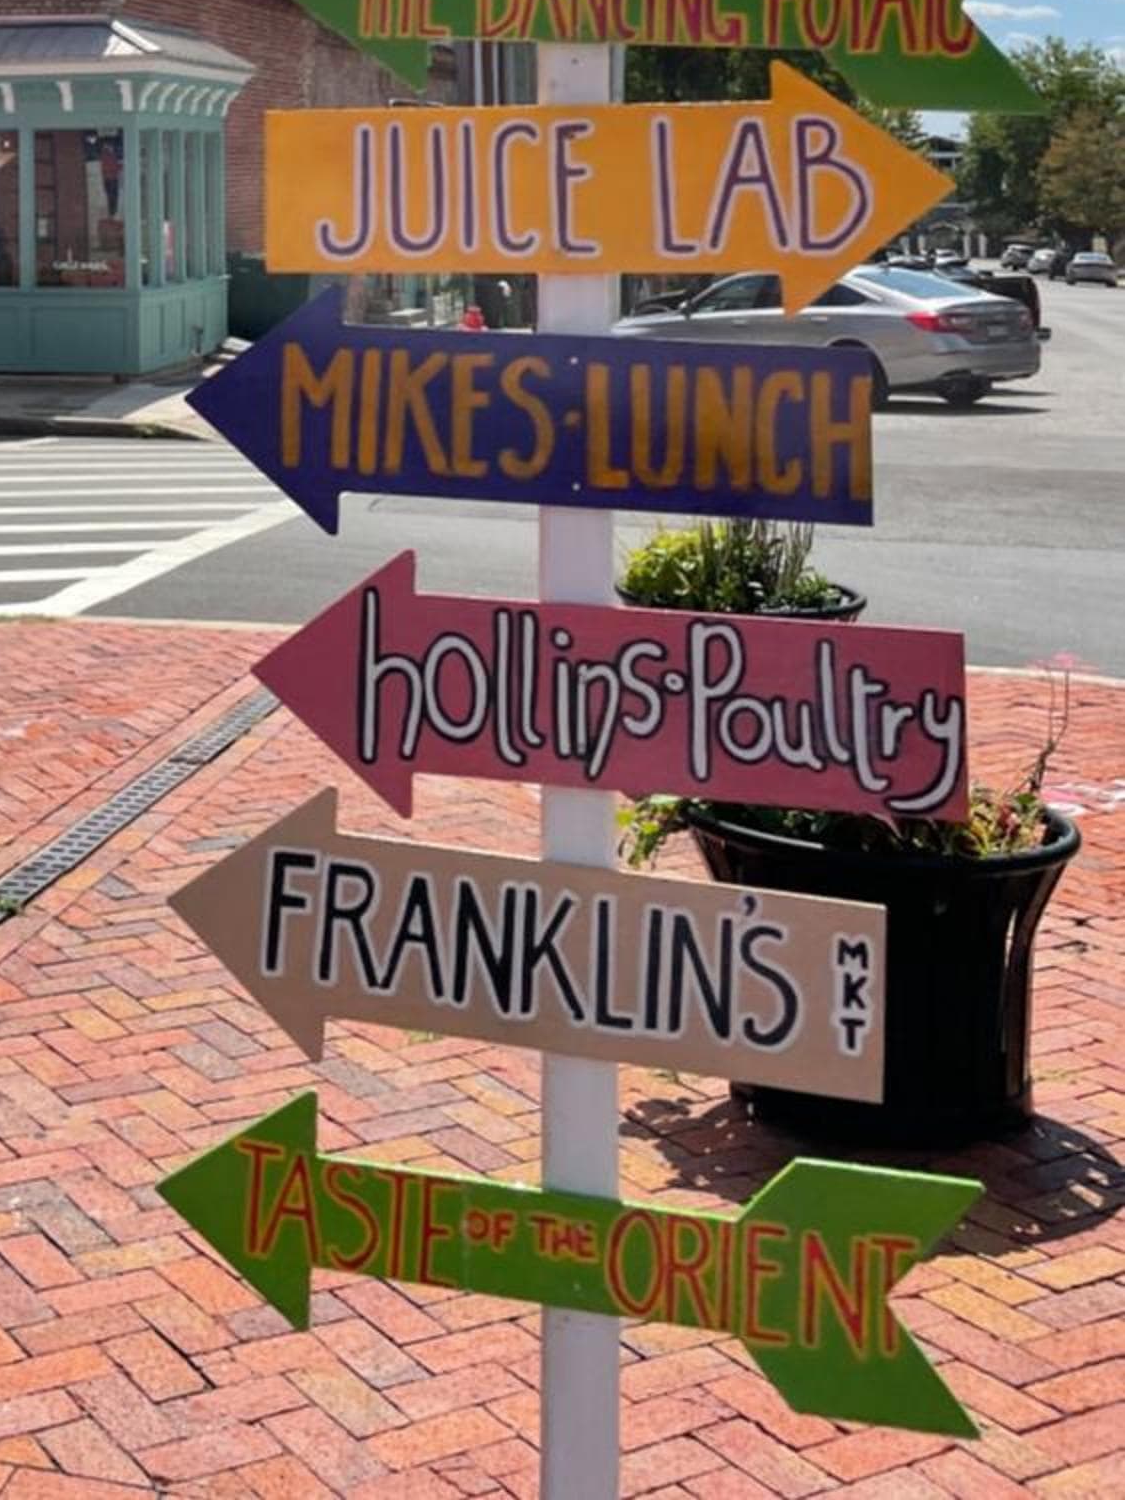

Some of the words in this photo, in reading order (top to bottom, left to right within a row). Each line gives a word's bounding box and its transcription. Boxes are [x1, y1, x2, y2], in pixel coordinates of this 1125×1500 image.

[319, 121, 599, 258] JUICE
[655, 117, 871, 255] LAB
[281, 342, 553, 480] MIKES
[585, 363, 872, 500] LUNCH
[687, 619, 962, 815] Poultry
[265, 852, 799, 1046] FRANKLIN'S
[238, 1141, 460, 1288] TASTE
[466, 1209, 515, 1249] OF
[531, 1214, 597, 1259] THE
[605, 1211, 919, 1356] ORIENT
